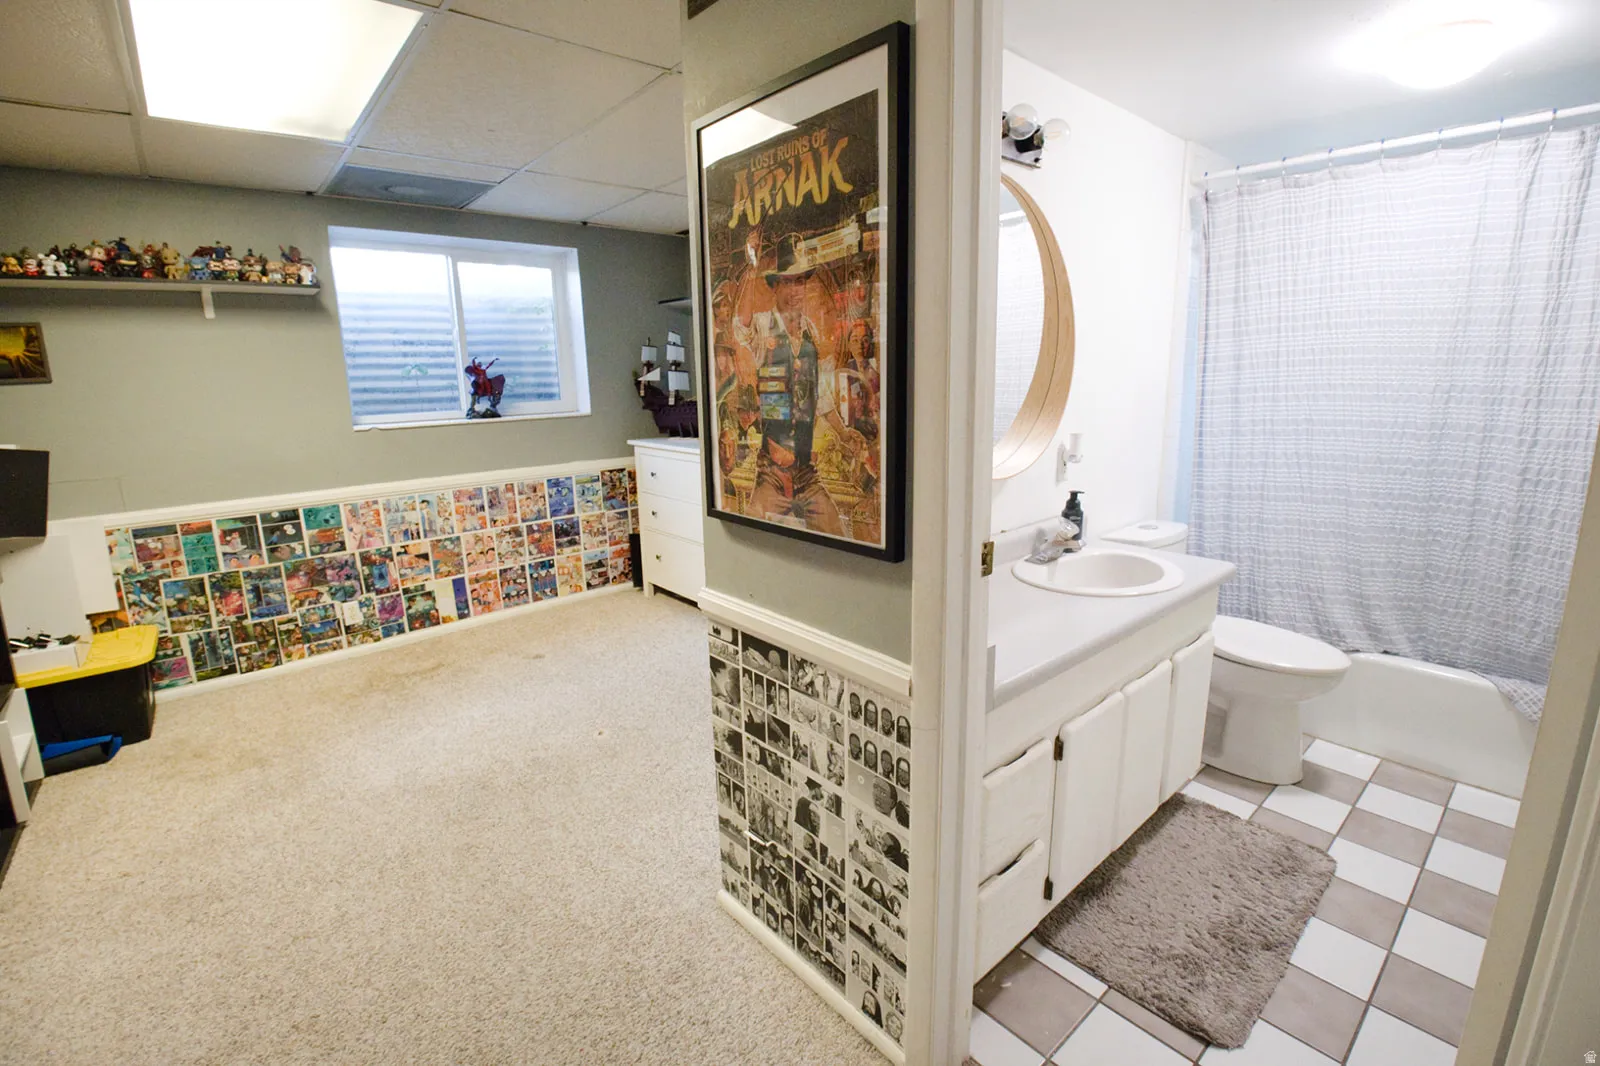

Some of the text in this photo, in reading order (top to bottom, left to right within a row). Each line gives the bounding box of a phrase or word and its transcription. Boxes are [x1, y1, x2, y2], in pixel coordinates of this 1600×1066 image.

[728, 137, 853, 229] ARNAK
[751, 128, 828, 171] LOST RUINS OF
